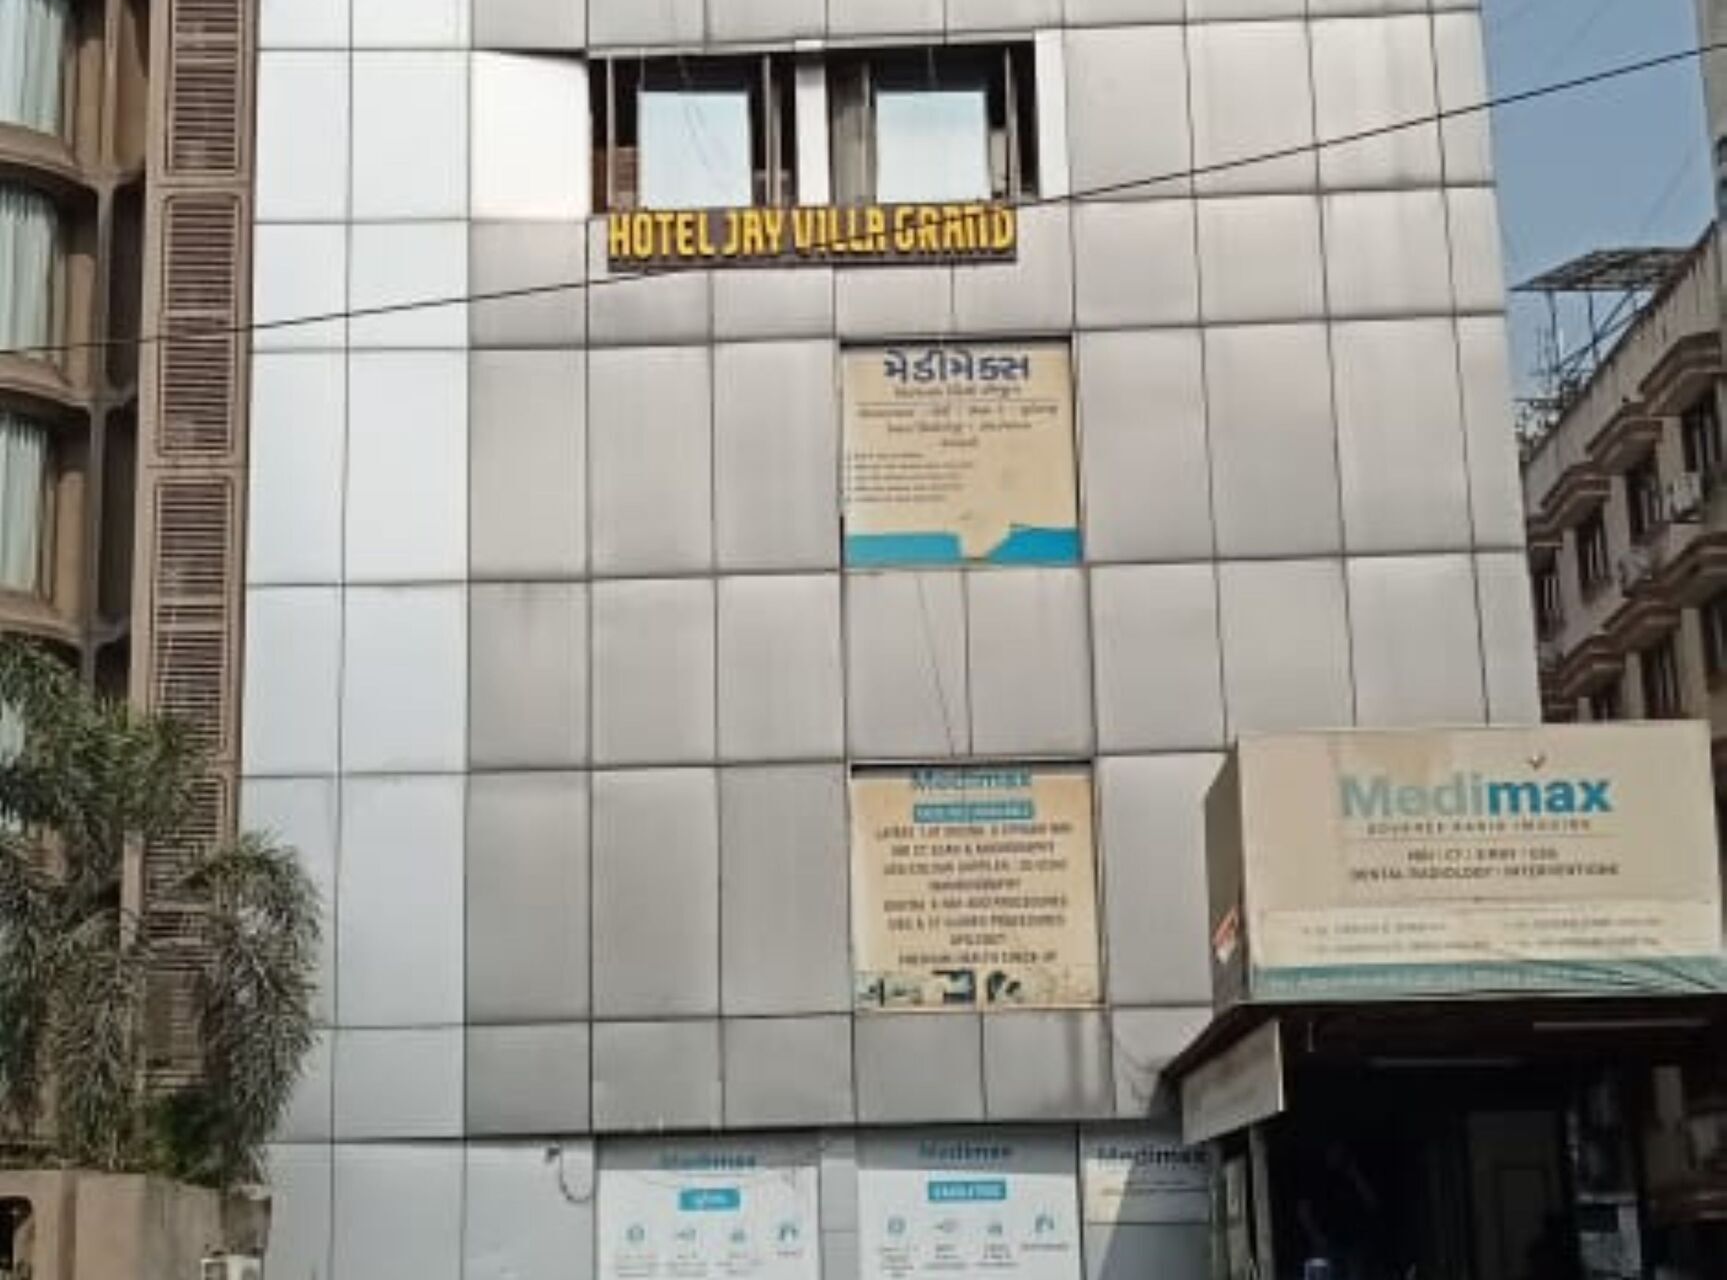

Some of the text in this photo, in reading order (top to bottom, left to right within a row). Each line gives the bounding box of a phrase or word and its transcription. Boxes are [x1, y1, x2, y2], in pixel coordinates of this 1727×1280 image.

[609, 203, 1015, 259] HOTEL JAY VILLA GRAND
[1341, 771, 1613, 818] Medimax
[1349, 862, 1621, 883] DENTAL RADIOLOGY INTERVENTIONS
